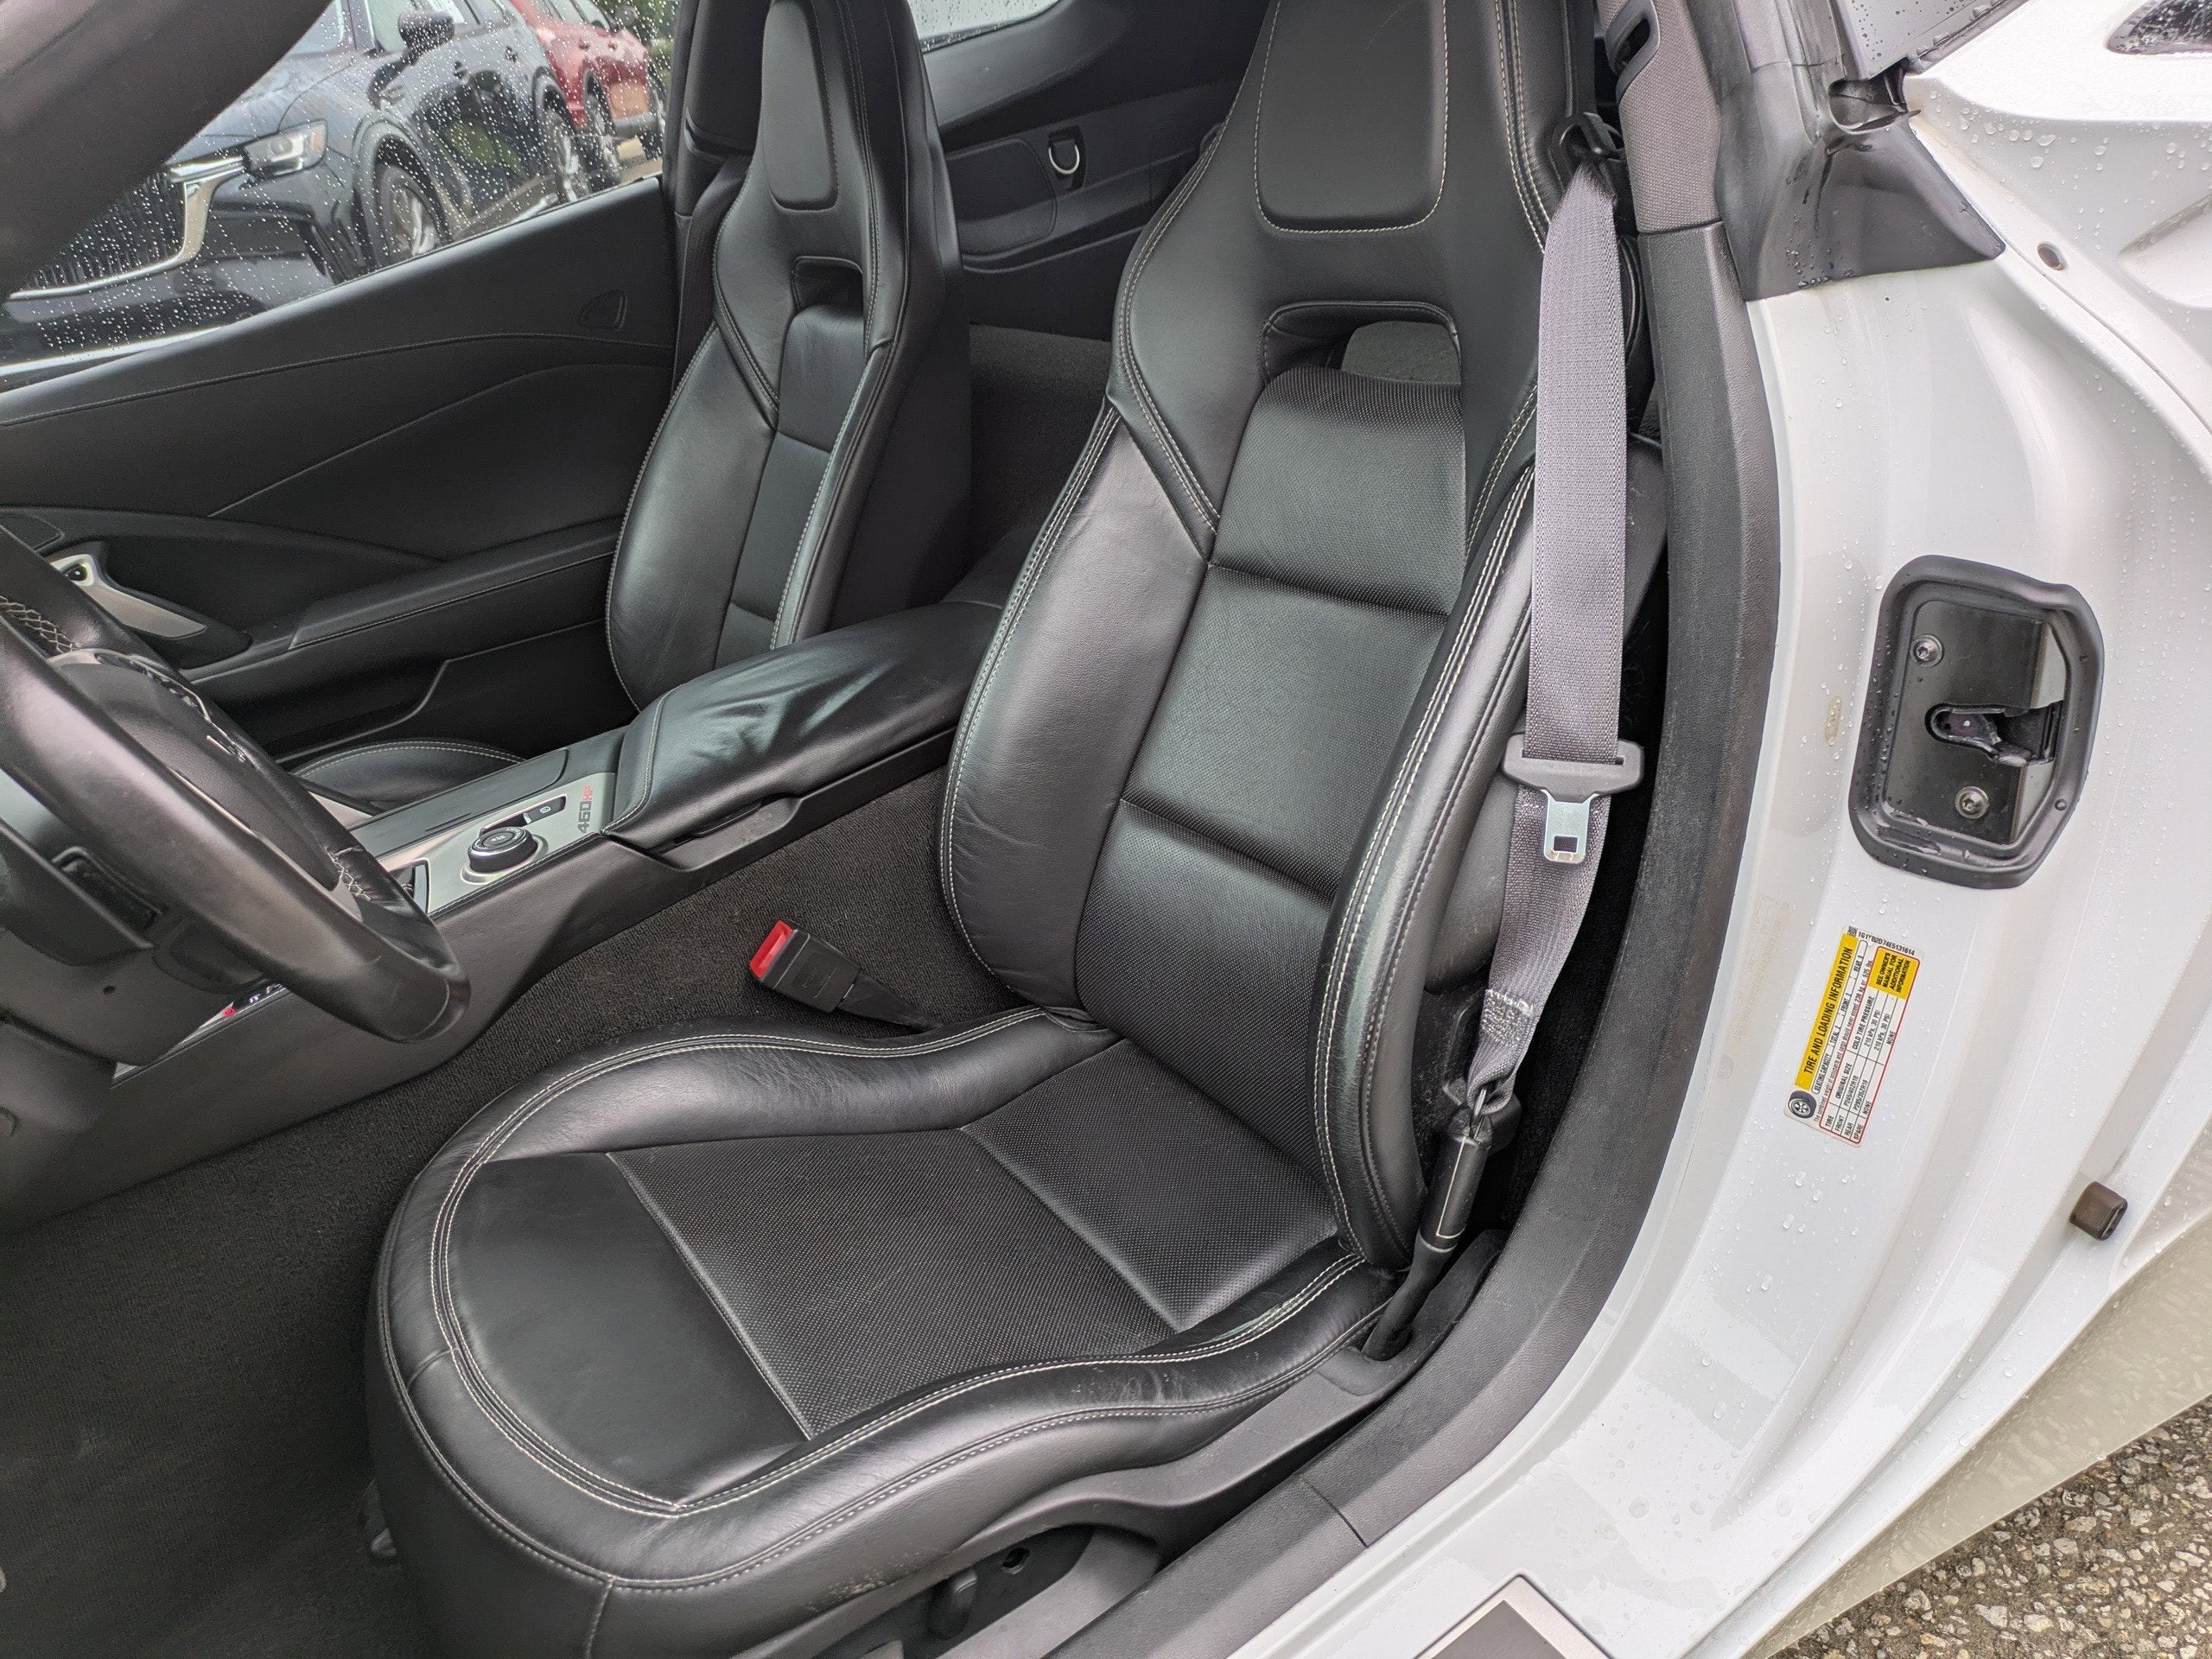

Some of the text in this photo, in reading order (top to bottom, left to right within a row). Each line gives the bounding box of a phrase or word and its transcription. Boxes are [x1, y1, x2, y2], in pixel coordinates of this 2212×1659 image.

[1853, 959, 1861, 972] REAR
[1888, 957, 1904, 989] ADDITIONAL
[1881, 965, 1893, 988] MANUAL
[1895, 959, 1910, 993] INFORMATION
[1803, 946, 1853, 1075] TIRE AND LOADING INFORMATION
[1840, 997, 1849, 1012] FRONT
[1851, 995, 1874, 1050] COLD TIRE PRESSURE
[1829, 1030, 1838, 1043] TOTAL
[1885, 1030, 1895, 1045] NONE
[1814, 1052, 1831, 1090] SEATING CAPACITY
[1835, 1062, 1852, 1099] ORIGINAL SIZE
[1862, 1100, 1872, 1115] NONE
[1825, 1115, 1834, 1128] TIRE
[1834, 1115, 1844, 1131] FRONT
[1844, 1122, 1853, 1135] REAR
[1853, 1123, 1862, 1140] SPARE
